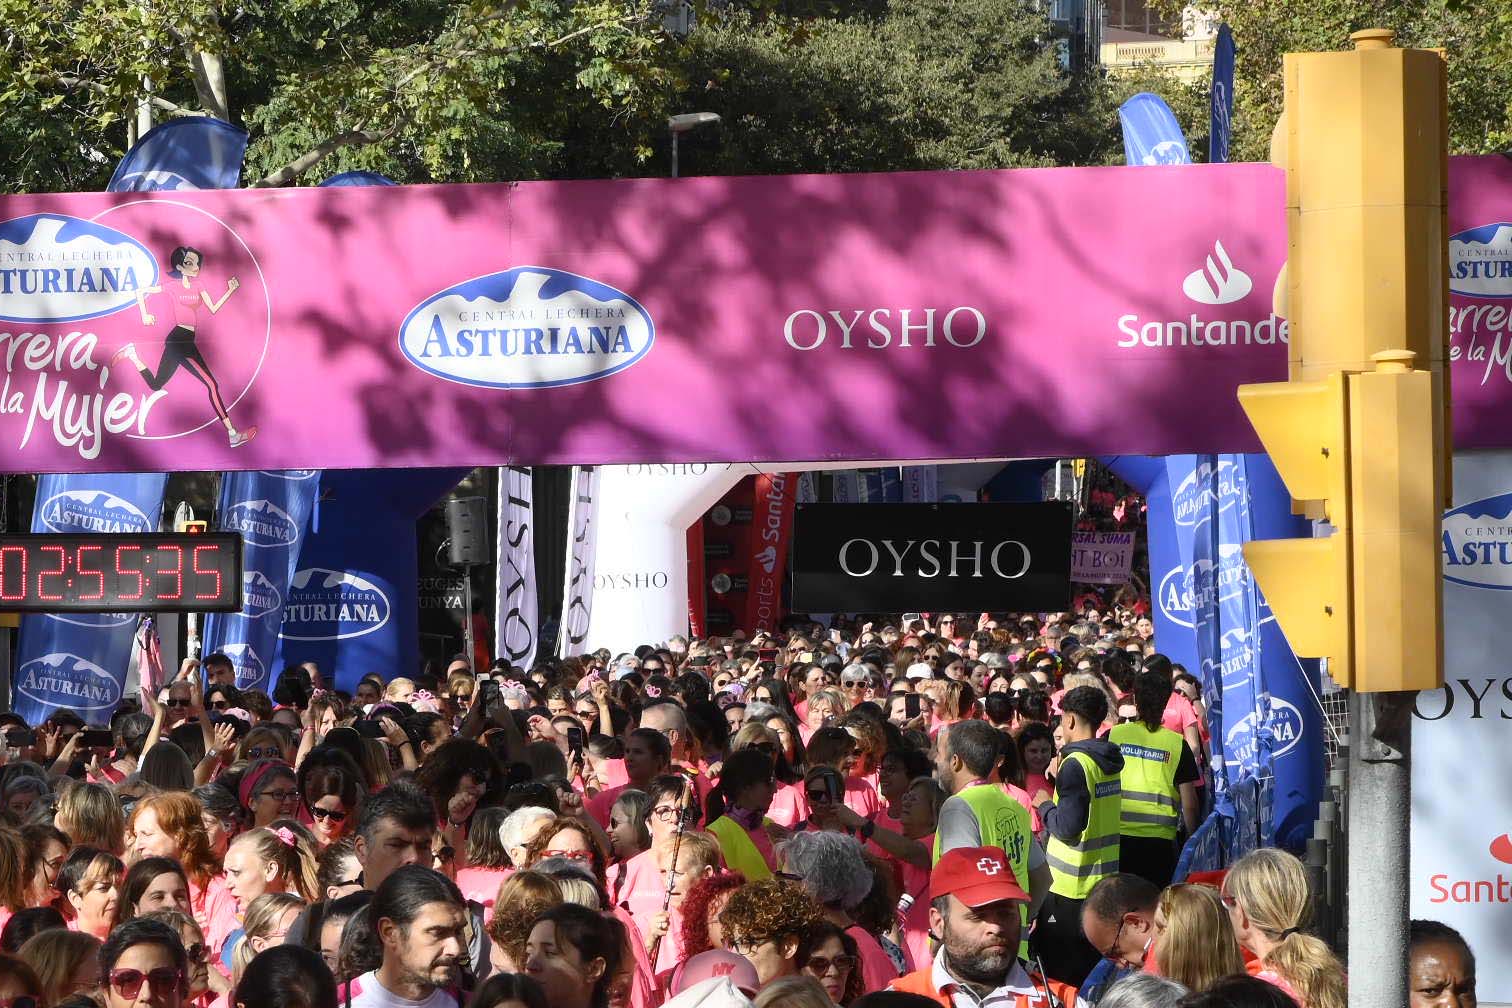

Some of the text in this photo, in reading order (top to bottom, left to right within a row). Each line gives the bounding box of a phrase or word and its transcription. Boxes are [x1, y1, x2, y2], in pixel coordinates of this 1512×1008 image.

[60, 250, 135, 262] LECHERA
[458, 307, 626, 322] CENTRAL LECHERA
[784, 305, 987, 350] OYSHO
[420, 313, 634, 359] ASTURIANA
[1117, 314, 1289, 348] Santande
[1467, 336, 1486, 362] la
[0, 373, 25, 414] la
[19, 367, 168, 460] Mujer
[47, 503, 143, 532] ASTURIANA
[1465, 527, 1512, 536] CENTR
[1100, 533, 1131, 545] SUMA
[503, 466, 532, 661] OYSH
[839, 538, 1032, 579] OYSHO
[593, 571, 668, 591] OYSHO
[22, 671, 112, 702] ASTURIANA
[1413, 679, 1512, 720] OYS
